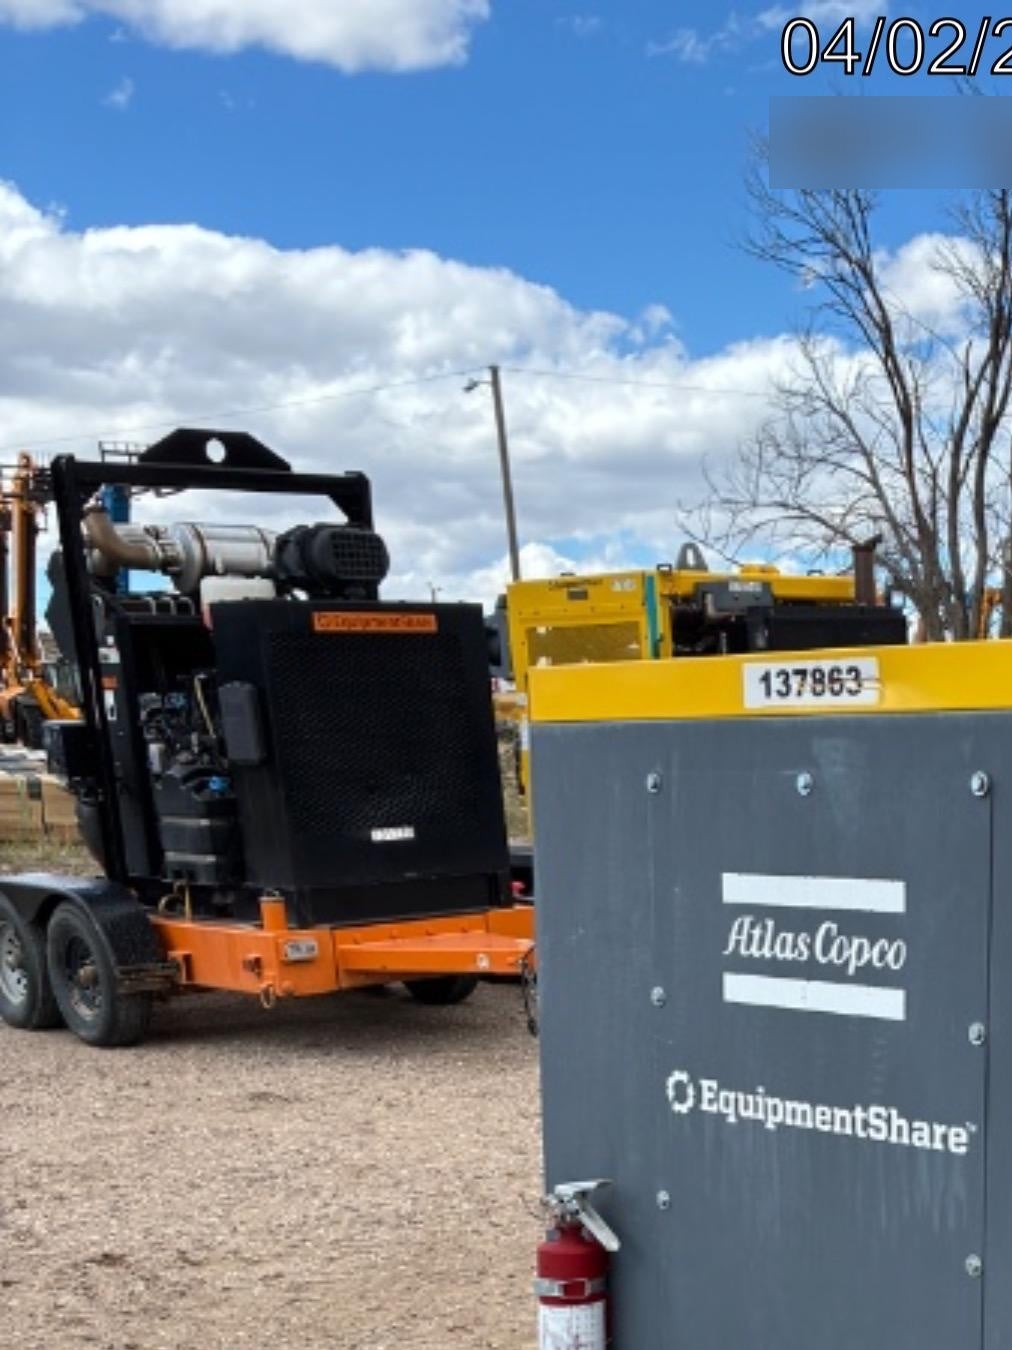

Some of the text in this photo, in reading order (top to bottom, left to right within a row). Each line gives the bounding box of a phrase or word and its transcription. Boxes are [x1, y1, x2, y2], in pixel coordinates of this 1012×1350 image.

[758, 664, 862, 699] 137863
[722, 914, 907, 977] Atlas Copco
